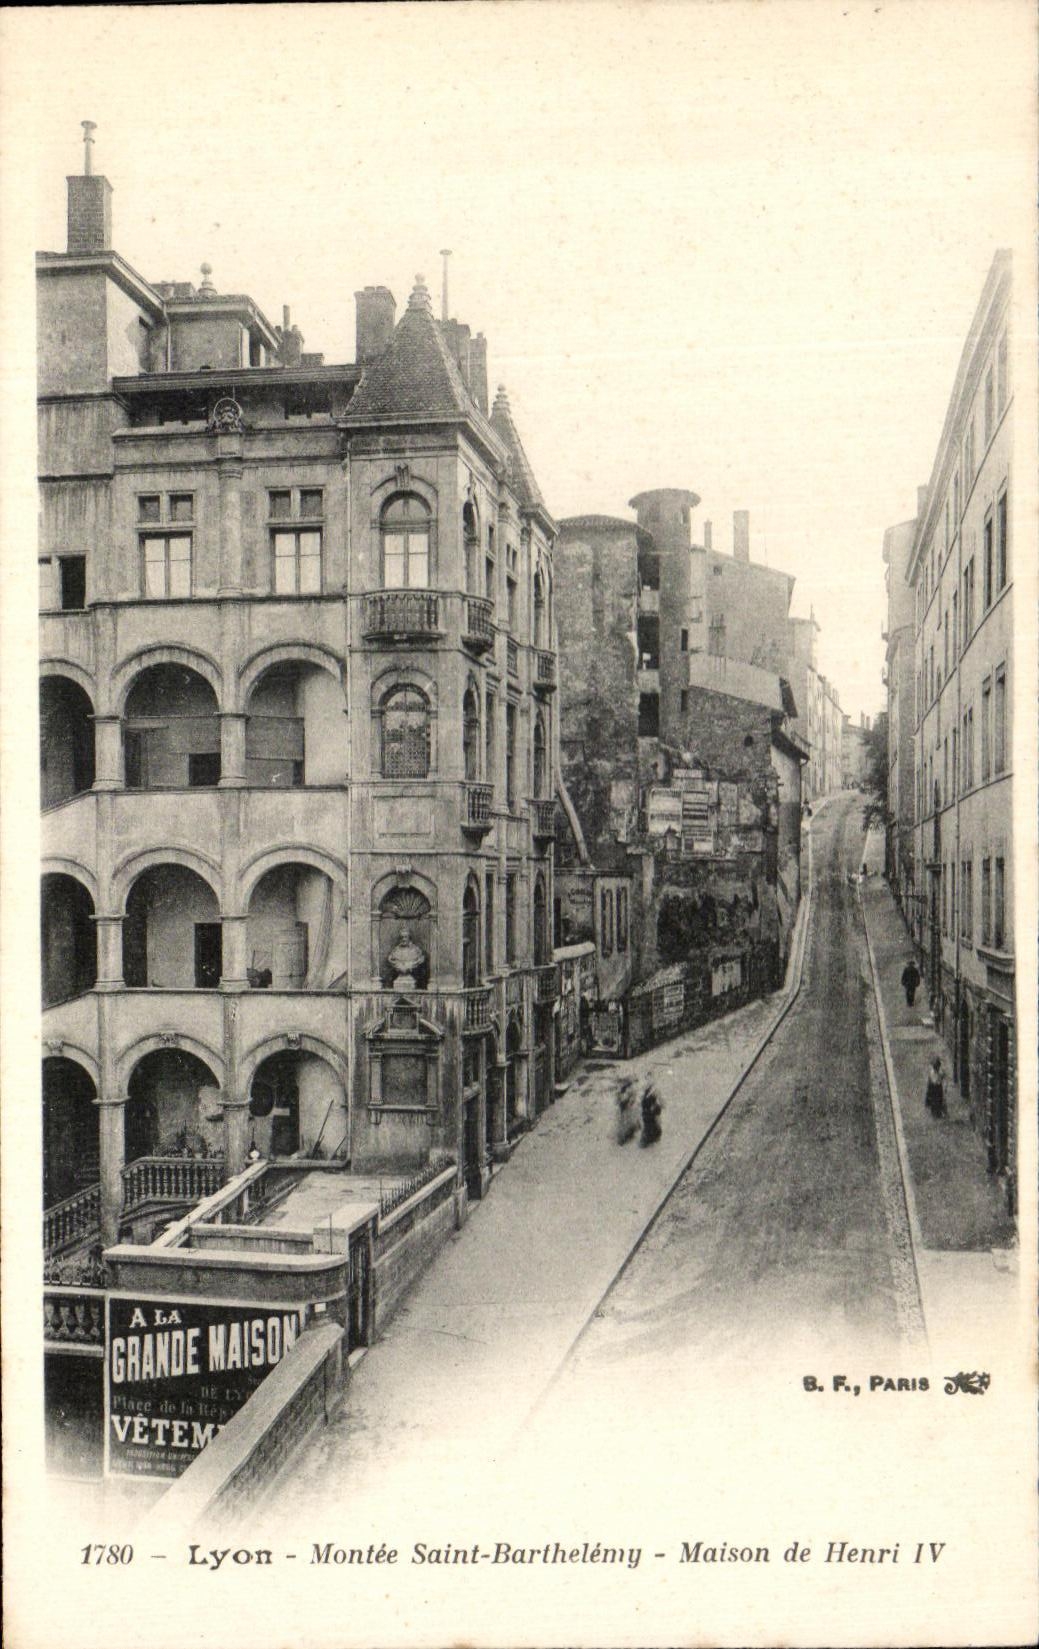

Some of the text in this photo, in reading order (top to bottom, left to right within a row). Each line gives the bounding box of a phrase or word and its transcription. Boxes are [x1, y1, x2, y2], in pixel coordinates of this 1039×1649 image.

[129, 1307, 182, 1328] A LA
[112, 1313, 298, 1384] GRANDE MAISON
[112, 1395, 152, 1412] Place
[160, 1399, 176, 1413] de
[181, 1400, 194, 1415] la
[111, 1413, 227, 1448] VÊTEM
